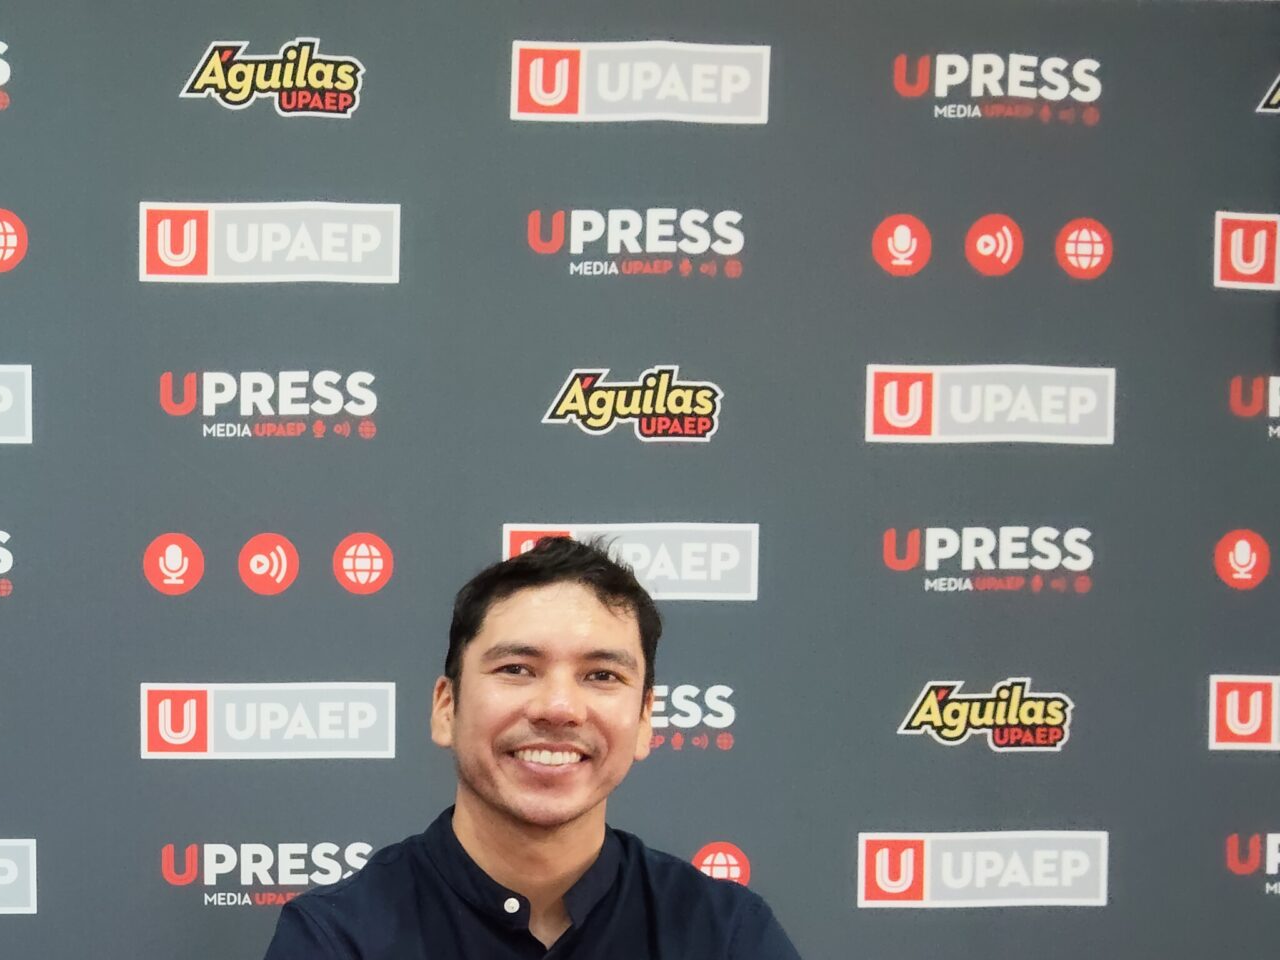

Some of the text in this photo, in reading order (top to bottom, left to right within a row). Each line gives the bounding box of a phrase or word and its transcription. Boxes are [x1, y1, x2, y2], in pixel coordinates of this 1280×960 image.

[194, 45, 355, 101] Águilas
[529, 58, 750, 106] U UPAEP
[894, 54, 1101, 102] UPRESS
[282, 91, 352, 111] UPAEP
[935, 105, 981, 117] MEDIA
[158, 219, 381, 267] U UPAEP
[528, 208, 744, 255] UPRESS
[1231, 229, 1266, 274] U
[570, 261, 619, 275] MEDIA
[160, 370, 377, 416] UPRESS
[558, 374, 712, 427] Águilas
[884, 381, 1096, 428] U UPAEP
[203, 423, 252, 437] MEDIA
[641, 417, 711, 434] UPAEP
[883, 526, 1093, 571] UPRESS
[925, 578, 973, 591] MEDIA
[159, 699, 377, 744] U UPAEP
[912, 686, 1063, 737] Águilas
[1226, 691, 1262, 735] U
[994, 727, 1062, 745] UPAEP
[876, 848, 1090, 893] U UPAEP
[205, 893, 252, 905] MEDIA
